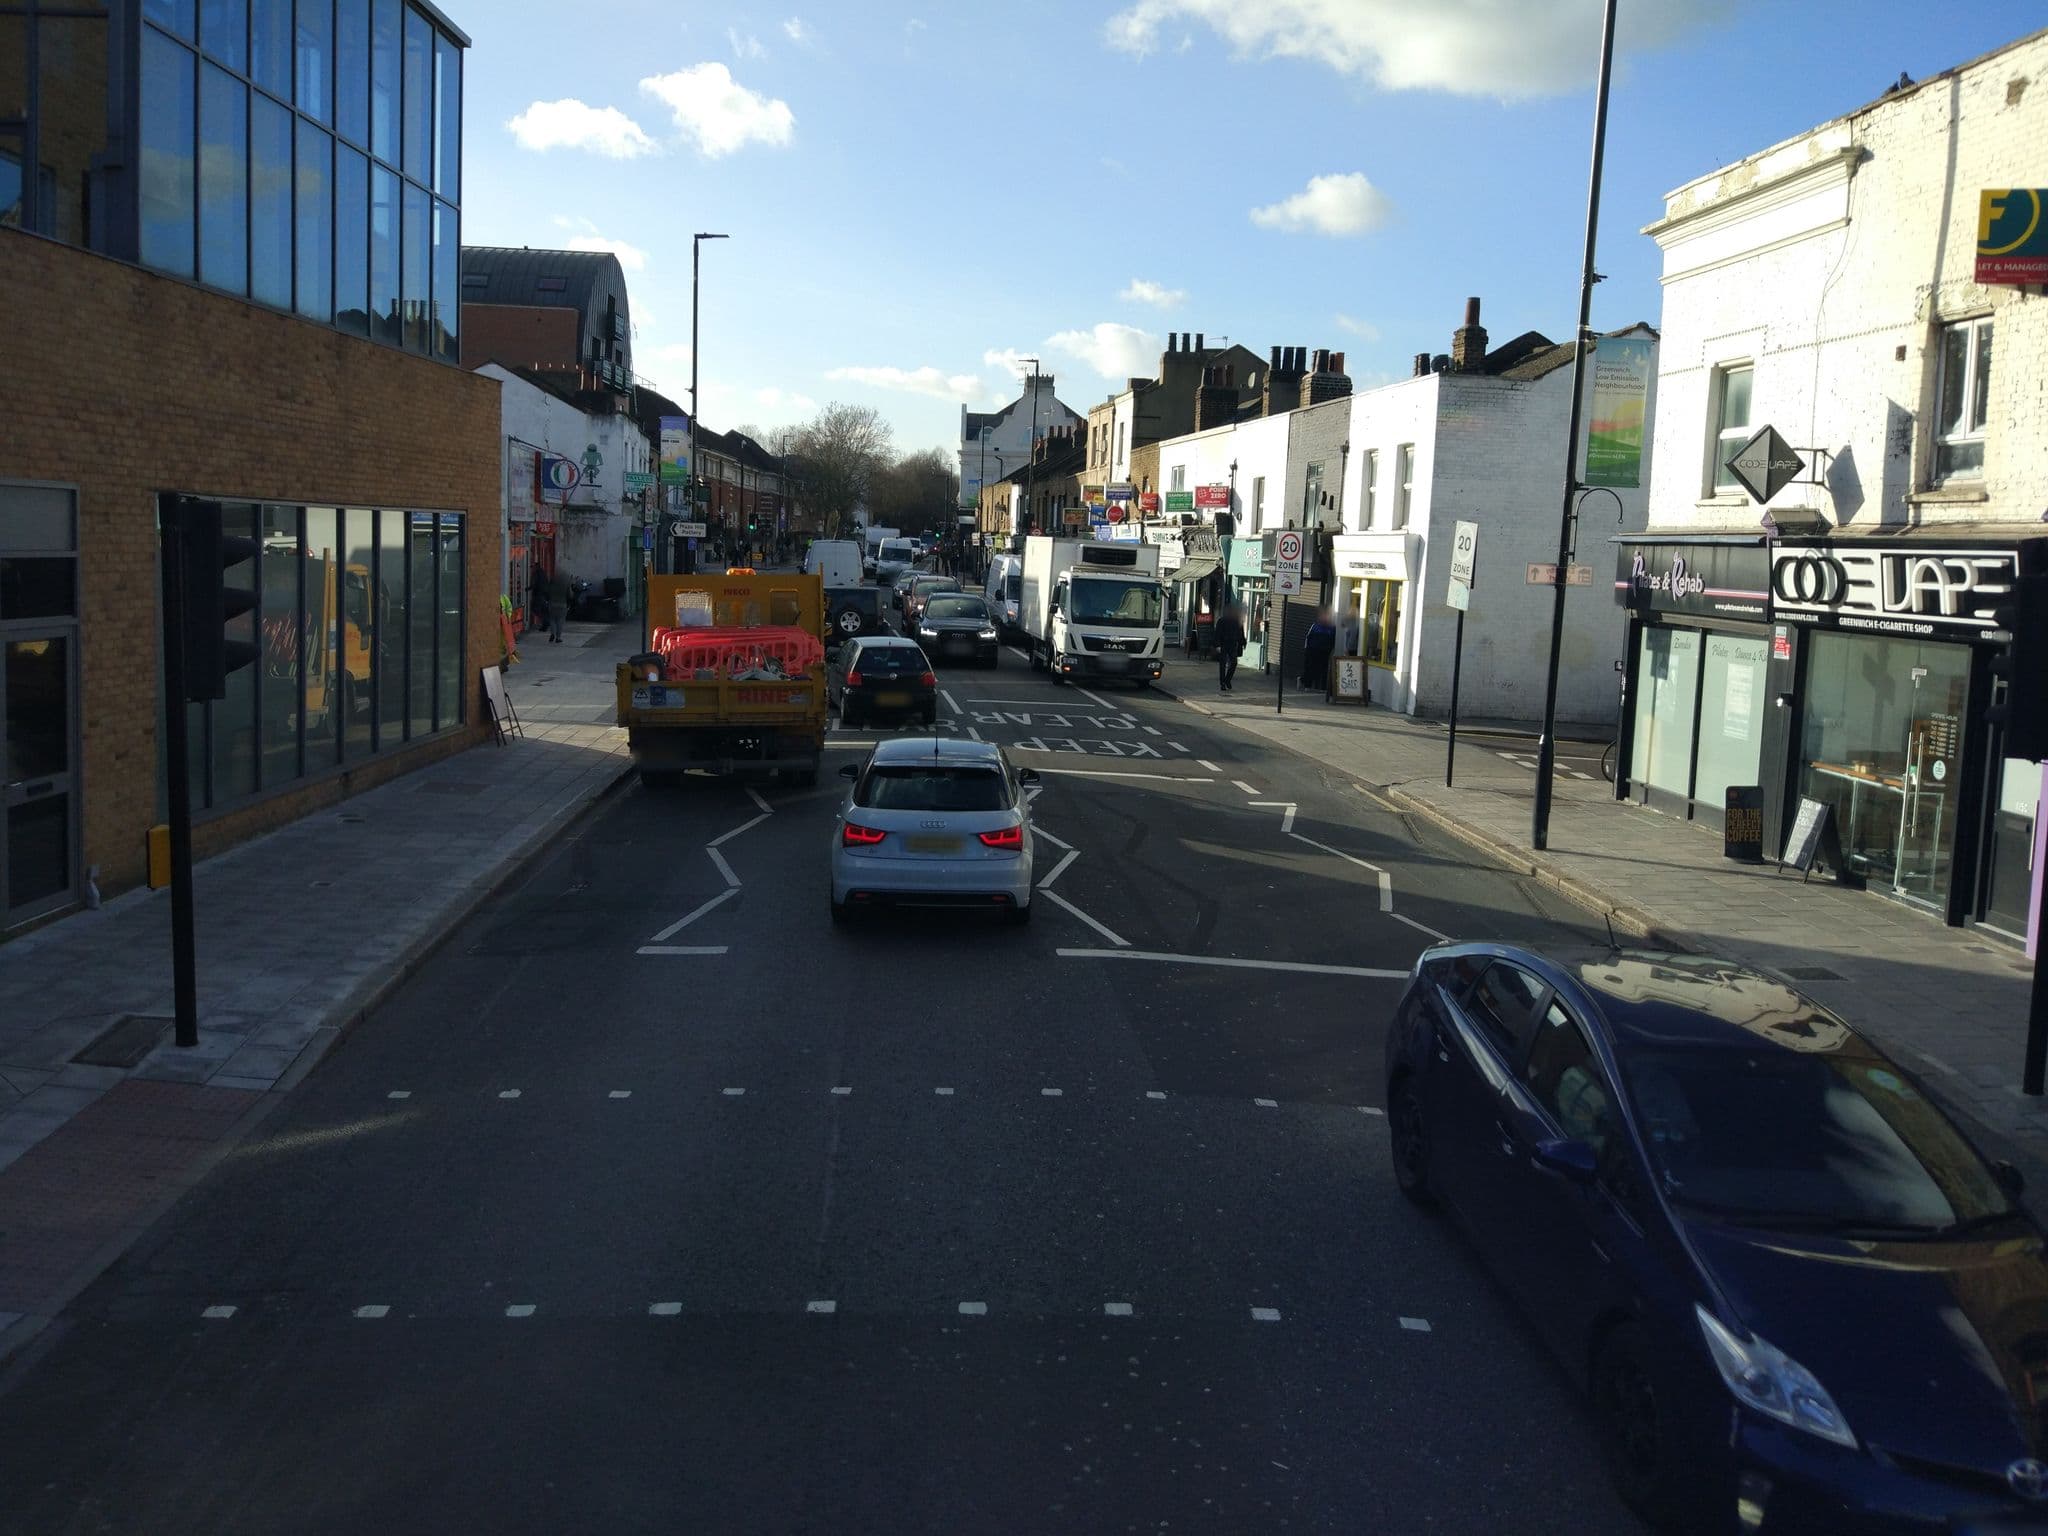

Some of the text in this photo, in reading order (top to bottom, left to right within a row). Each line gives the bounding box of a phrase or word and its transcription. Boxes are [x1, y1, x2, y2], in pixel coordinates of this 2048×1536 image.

[1282, 541, 1298, 553] 20
[1458, 535, 1472, 551] 20
[1278, 562, 1299, 570] ZONE
[1453, 563, 1470, 575] ZONE
[1631, 550, 1705, 602] Pilates & Rehab
[723, 588, 751, 596] IVECO
[1773, 555, 2011, 616] CODE VAPE
[1838, 617, 1934, 634] GREENWICH E-CIGARETTE SHOP
[970, 711, 1137, 729] CLEAR
[1012, 737, 1163, 757] KEEP
[1727, 808, 1743, 819] FOR
[1727, 830, 1761, 842] COFFEE
